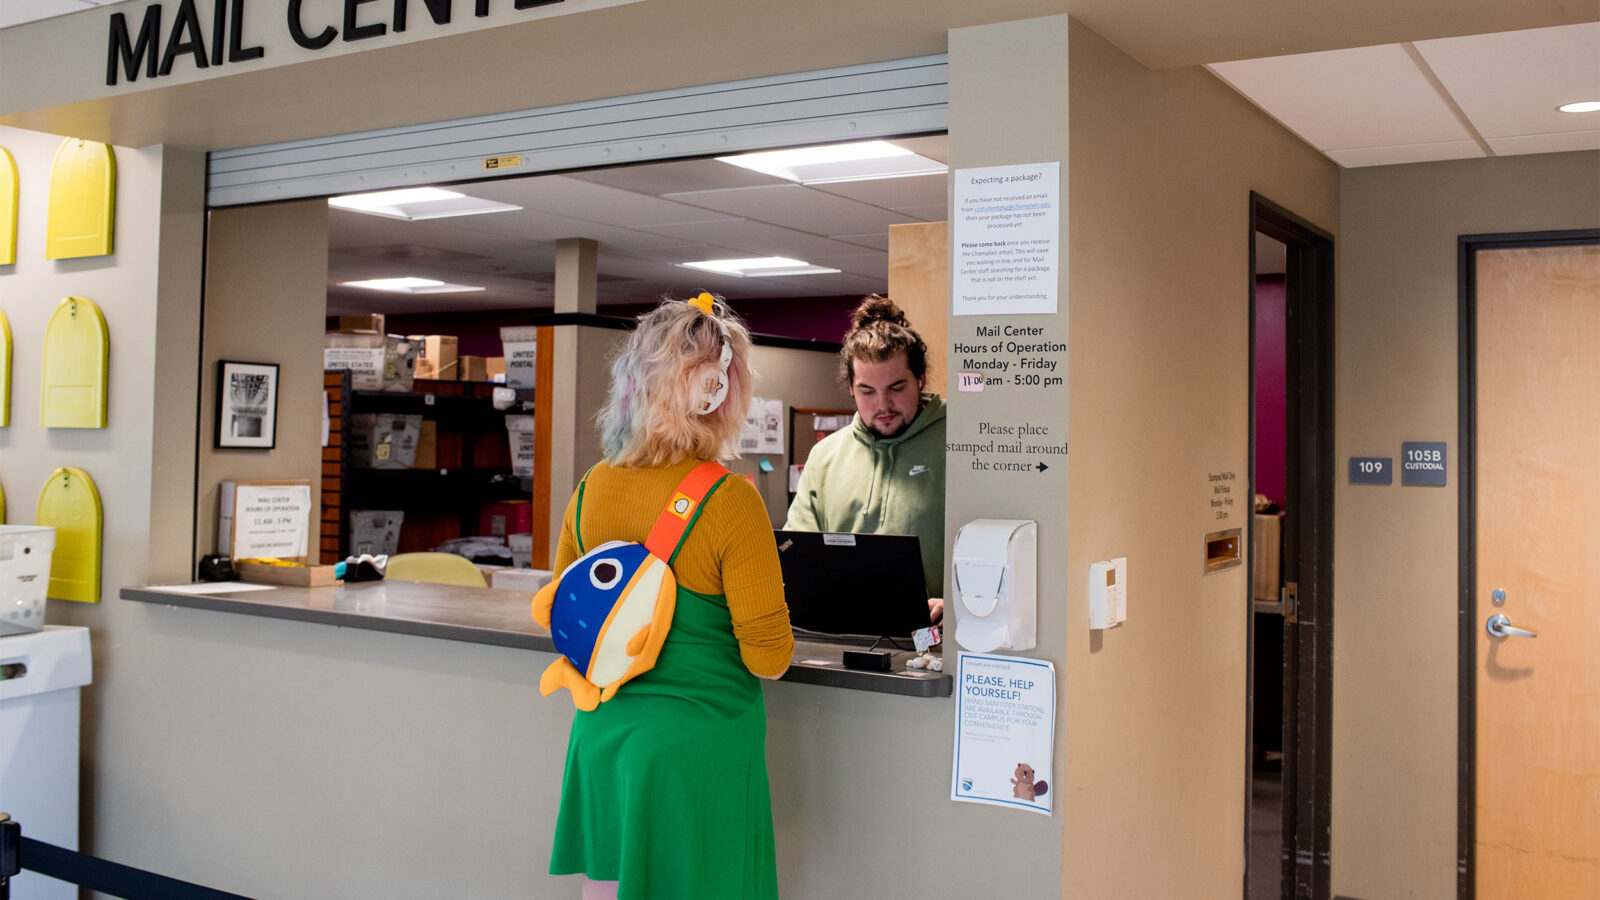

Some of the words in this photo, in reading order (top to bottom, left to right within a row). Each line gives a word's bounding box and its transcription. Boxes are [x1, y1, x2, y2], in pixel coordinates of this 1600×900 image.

[106, 0, 264, 86] MAIL
[971, 177, 1004, 185] Expecting
[1010, 172, 1042, 183] package?
[1003, 194, 1025, 202] received
[990, 213, 1012, 221] package
[972, 249, 998, 257] Champlain
[976, 258, 994, 266] waiting
[976, 325, 1000, 336] Mail
[1004, 326, 1043, 336] Center
[954, 343, 987, 353] Hours
[991, 341, 1003, 353] of
[1006, 341, 1066, 355] Operation
[512, 351, 535, 359] UNITED
[510, 360, 534, 368] POSTAL
[963, 358, 1009, 372] Monday
[1021, 357, 1057, 372] Friday
[963, 376, 983, 386] 11:00
[986, 377, 1003, 385] am
[1014, 375, 1040, 385] 5:00
[1044, 377, 1062, 388] pm
[979, 422, 1014, 435] Please
[1018, 422, 1048, 439] place
[945, 440, 994, 456] stamped
[998, 441, 1022, 453] mail
[1026, 442, 1068, 454] around
[1407, 450, 1441, 462] 105B
[972, 458, 990, 470] the
[993, 462, 1032, 471] corner
[1359, 462, 1383, 473] 109
[1405, 462, 1444, 470] CUSTODIAL
[1211, 498, 1222, 509] Monday
[1224, 497, 1234, 508] Friday
[966, 674, 1006, 688] PLEASE,
[1009, 679, 1034, 690] HELP
[966, 686, 1020, 701] YOURSELF!
[978, 706, 1009, 715] AVAILABLE
[985, 700, 1016, 709] SANITIZER
[1018, 704, 1045, 714] STATIONS
[979, 713, 1004, 722] CAMPUS
[1022, 719, 1037, 727] YOUR
